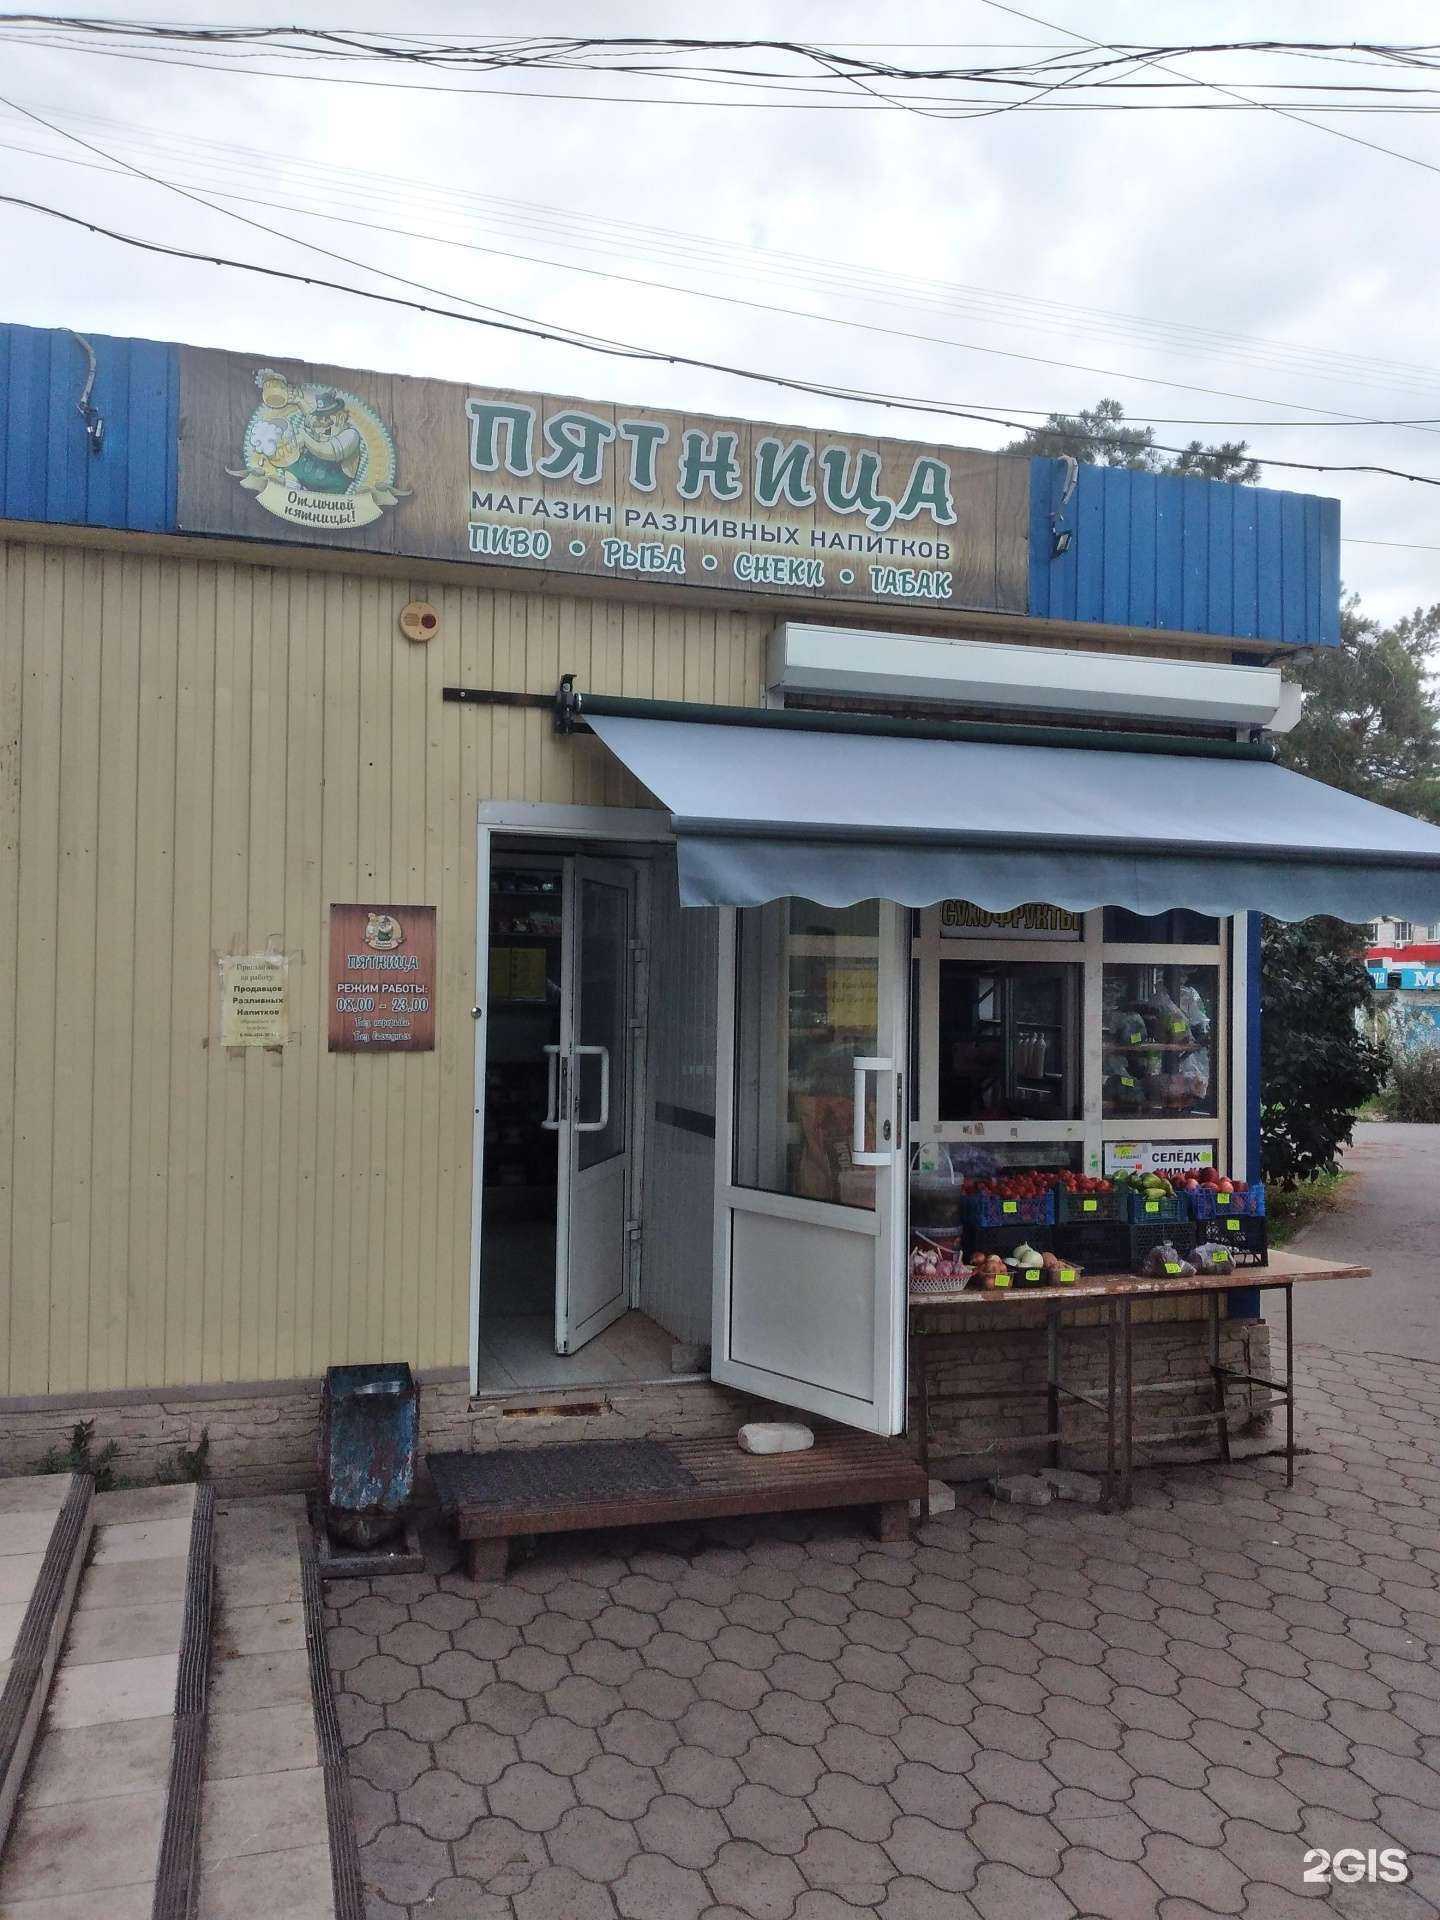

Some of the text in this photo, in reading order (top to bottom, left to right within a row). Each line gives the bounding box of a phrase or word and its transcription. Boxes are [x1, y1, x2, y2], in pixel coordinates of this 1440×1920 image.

[466, 400, 956, 531] ПЯТНИЦА
[288, 491, 355, 511] Отличной
[285, 506, 356, 525] пятницы!
[472, 491, 950, 560] МАГАЗИН РАЗЛИВНЫХ НАПИТКОВ
[469, 523, 952, 597] ПИВО РЫБА СНЕКИ ТАБАК
[348, 955, 419, 972] ПЯТНИЦА
[233, 985, 283, 994] Продавцов
[337, 983, 428, 993] РЕЖИМ РАБОТЫ:
[232, 996, 284, 1005] Разливных
[391, 998, 429, 1013] 23.00
[236, 1008, 280, 1016] Напитков
[1151, 1149, 1201, 1164] СЕЛЁДК
